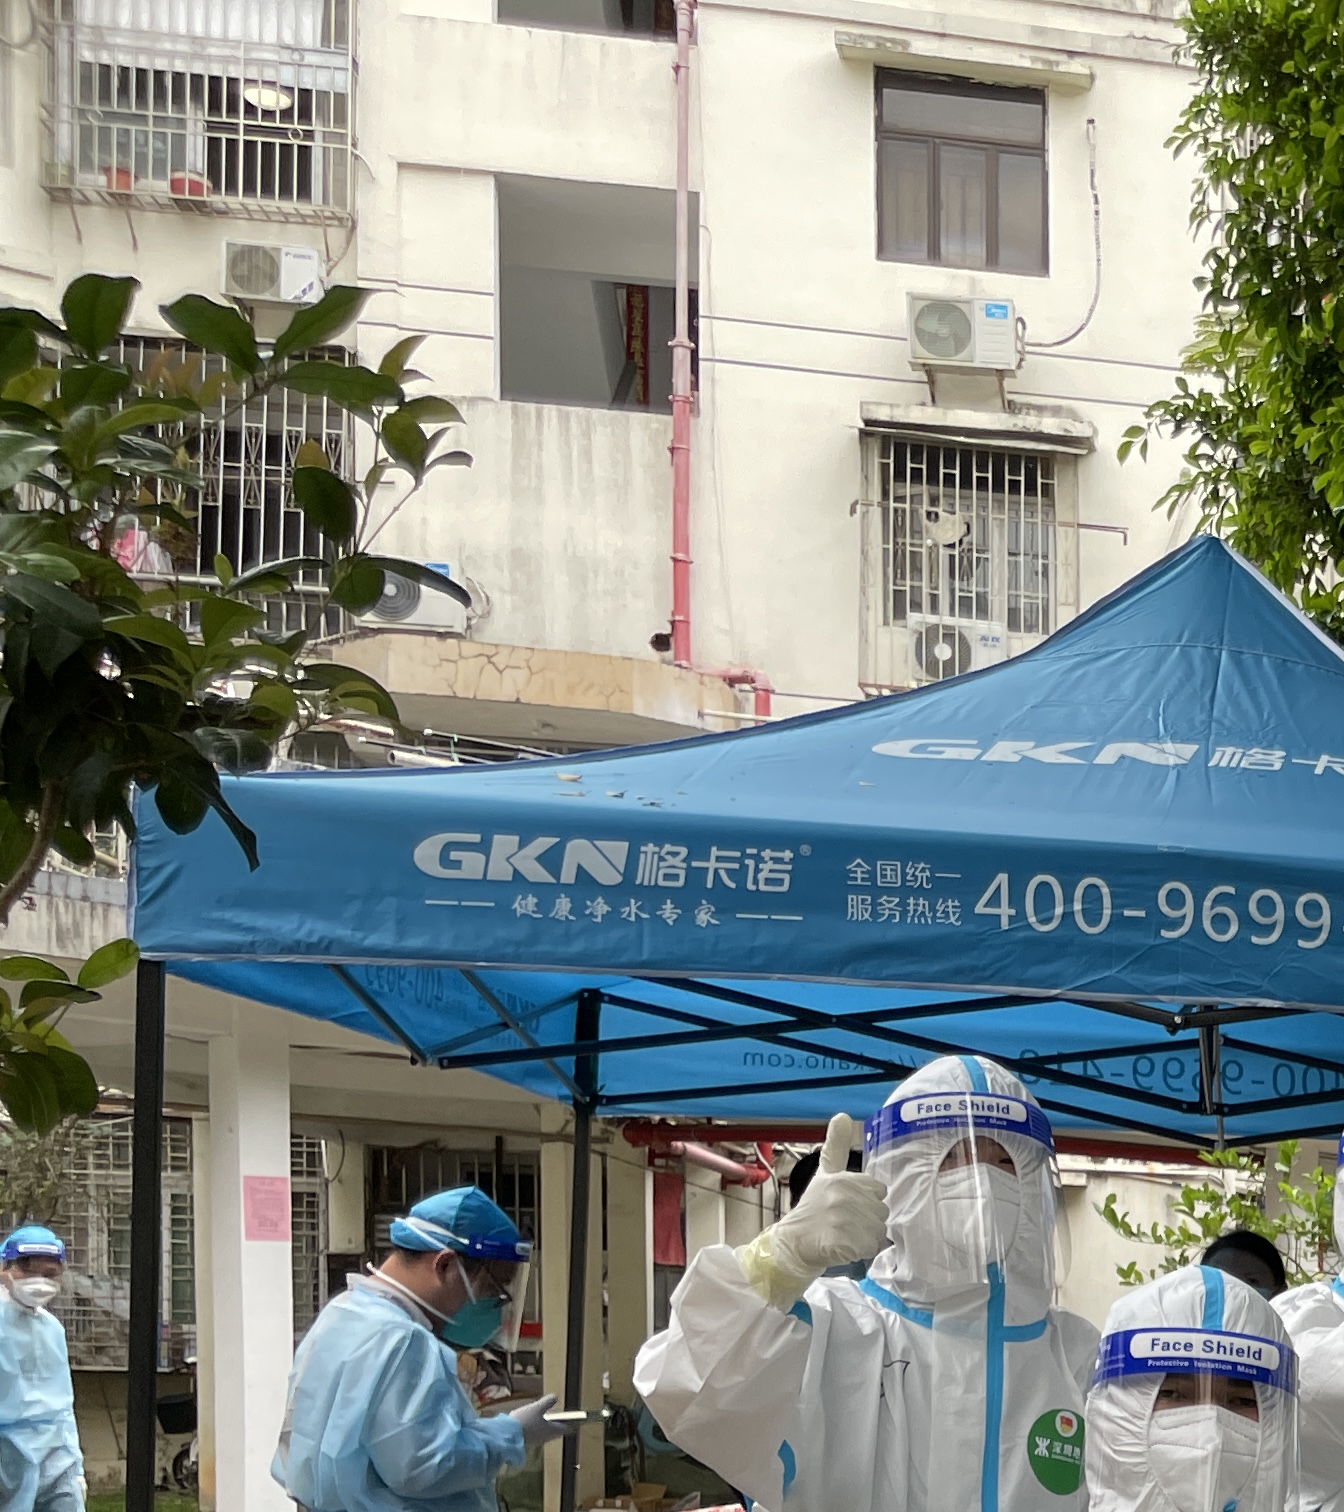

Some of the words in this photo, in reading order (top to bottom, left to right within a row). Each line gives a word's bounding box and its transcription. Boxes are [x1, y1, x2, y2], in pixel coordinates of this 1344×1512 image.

[871, 738, 1200, 766] GKN
[413, 832, 630, 886] GKN
[635, 843, 795, 893] 格卡诺
[846, 857, 962, 891] 全国统一
[511, 894, 721, 929] 健康净水专家
[846, 895, 963, 927] 服务热线
[917, 1102, 952, 1115] Face
[958, 1099, 1011, 1115] Shield
[1150, 1338, 1194, 1352] Face
[1201, 1339, 1263, 1361] Shield
